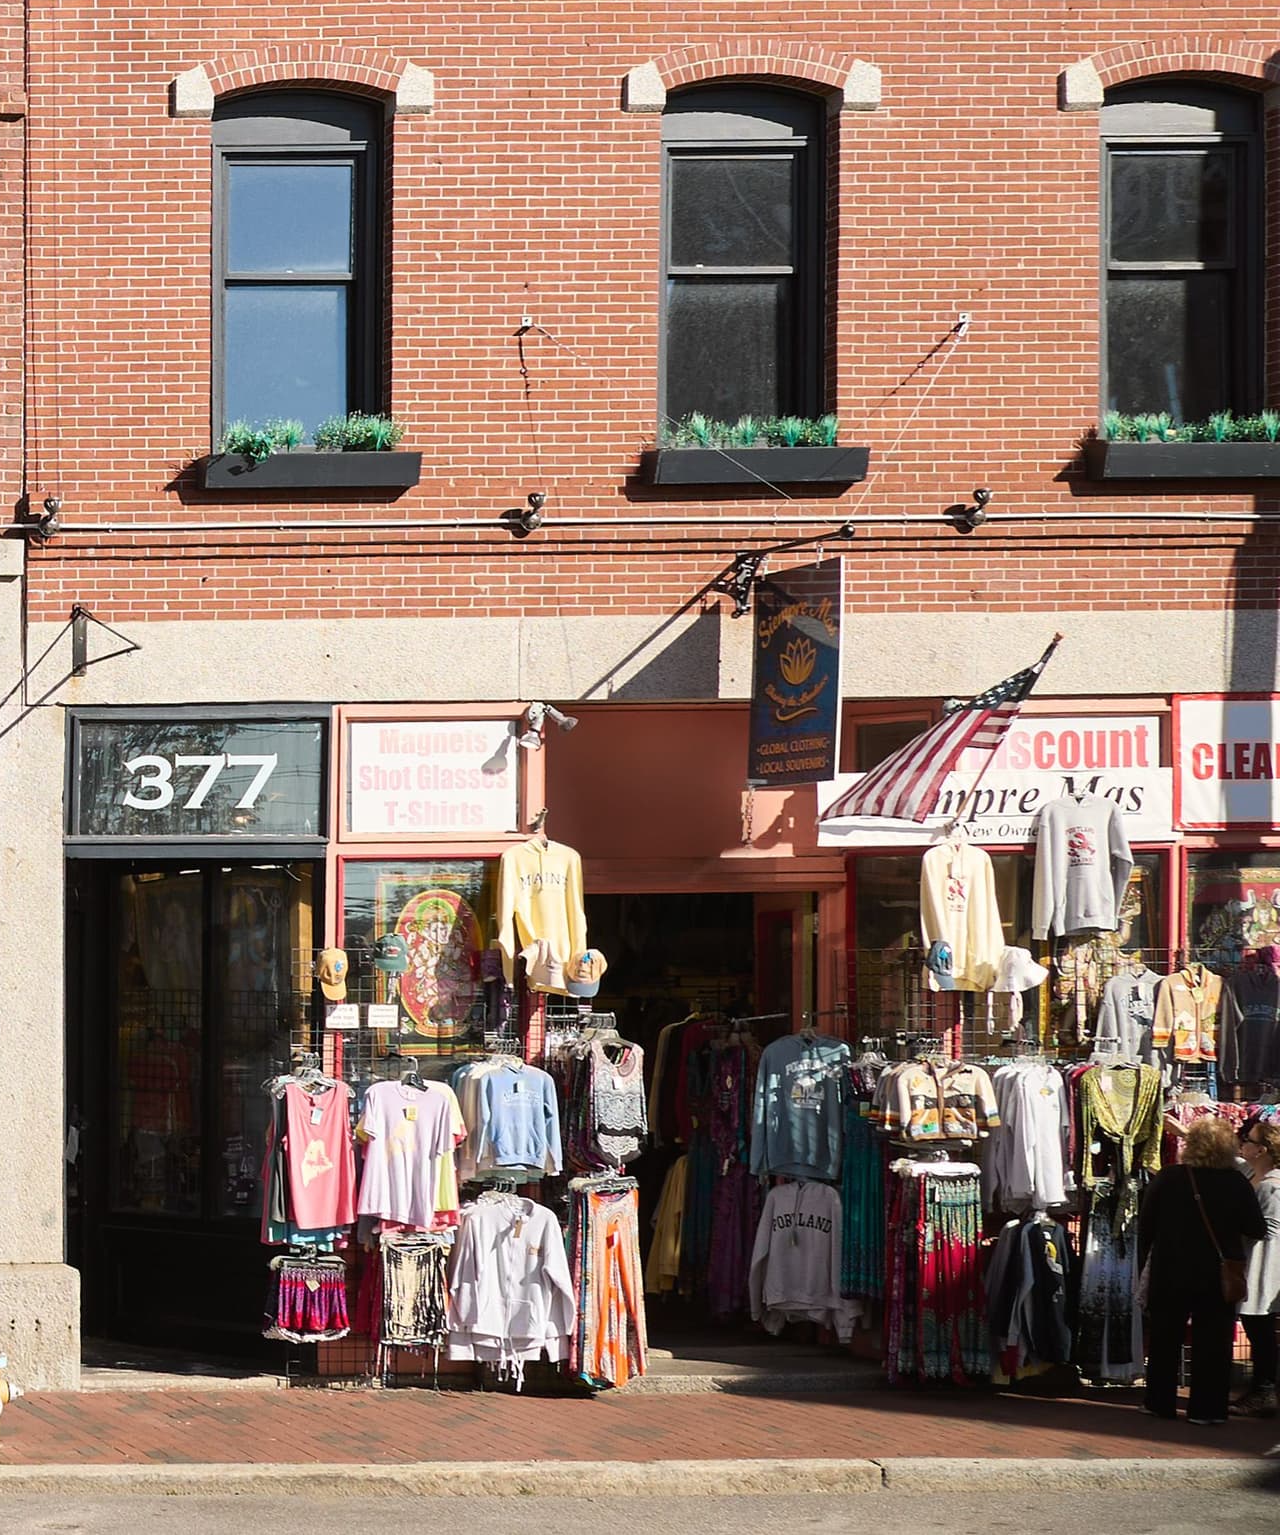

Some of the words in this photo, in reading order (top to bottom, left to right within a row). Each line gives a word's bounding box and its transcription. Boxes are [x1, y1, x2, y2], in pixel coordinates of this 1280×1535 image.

[379, 728, 488, 758] Magnets
[1192, 743, 1280, 780] CLEA
[122, 753, 278, 810] 377
[359, 765, 411, 790] Shot
[417, 764, 508, 790] Glasses
[385, 801, 484, 826] T-Shirts
[963, 824, 992, 837] New
